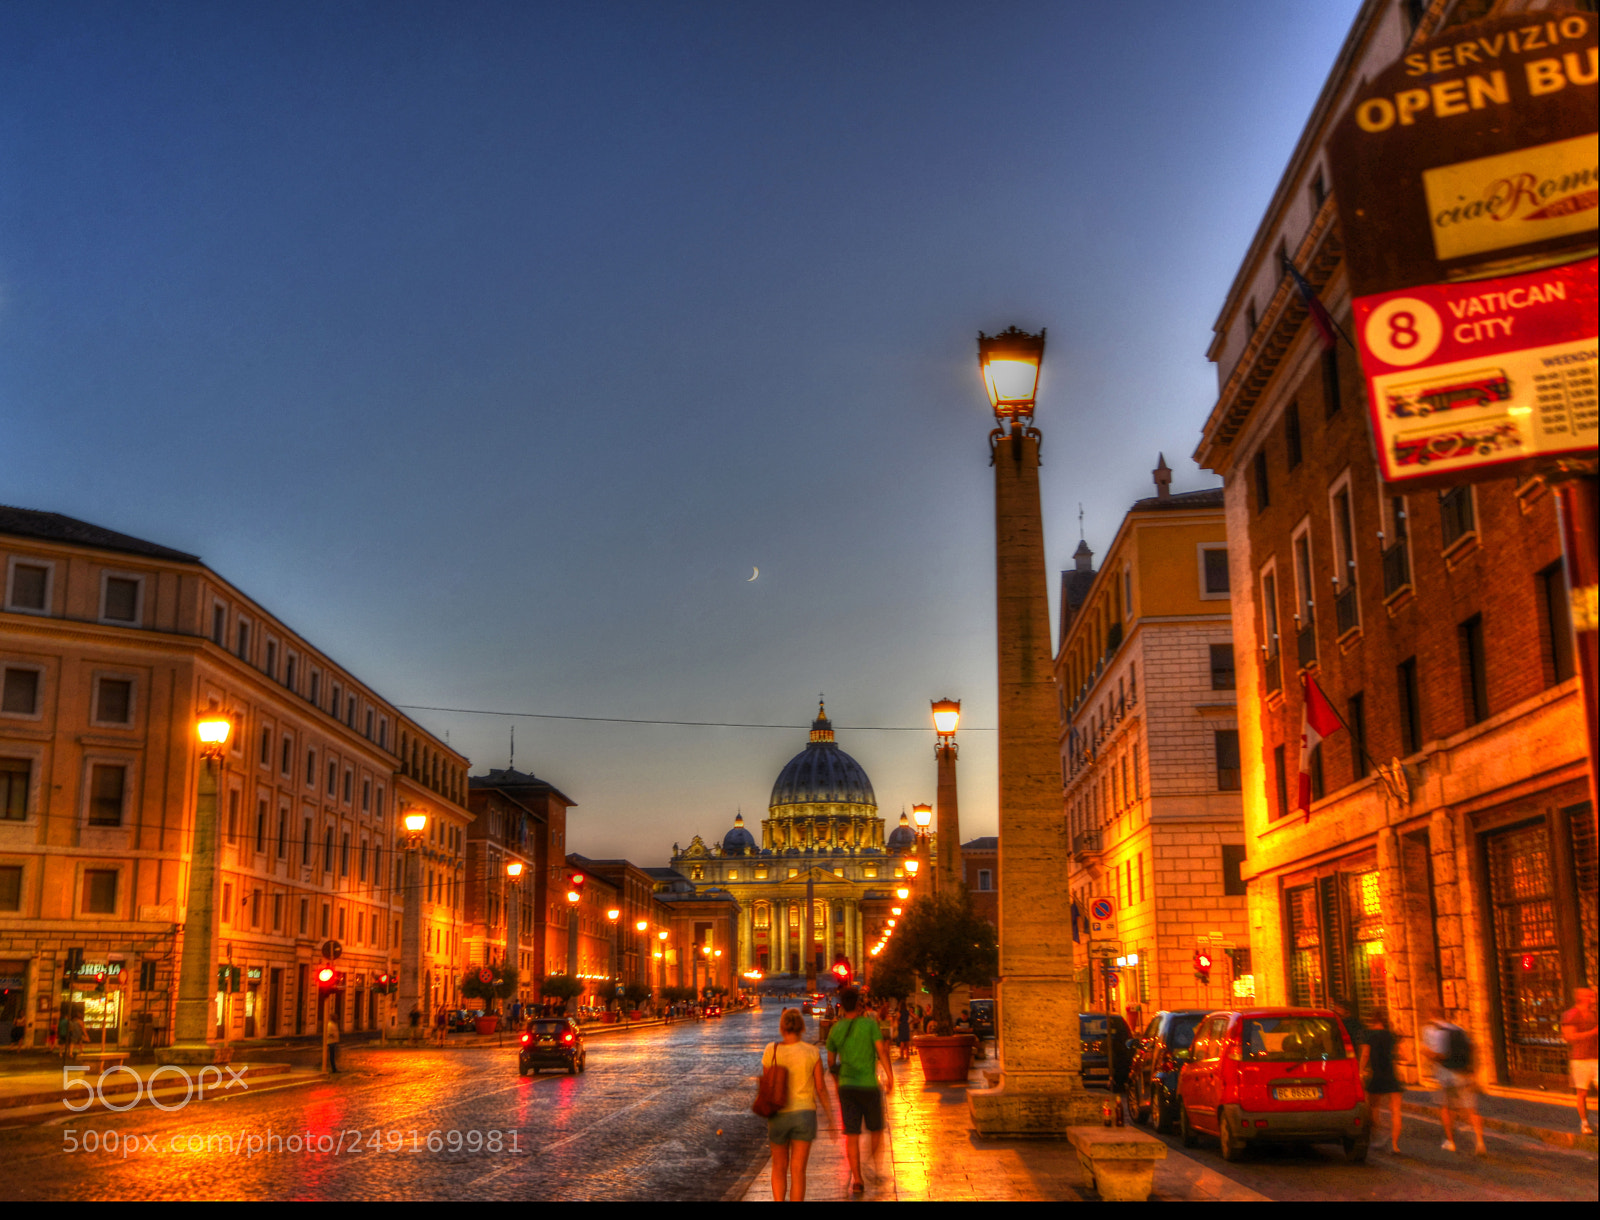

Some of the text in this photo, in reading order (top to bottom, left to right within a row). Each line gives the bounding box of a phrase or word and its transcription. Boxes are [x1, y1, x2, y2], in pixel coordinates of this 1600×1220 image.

[1405, 16, 1588, 76] SERVIZIO
[1356, 70, 1509, 133] OPEN
[1448, 281, 1566, 319] VATICAN
[1388, 311, 1419, 350] 8
[1454, 316, 1515, 343] CITY
